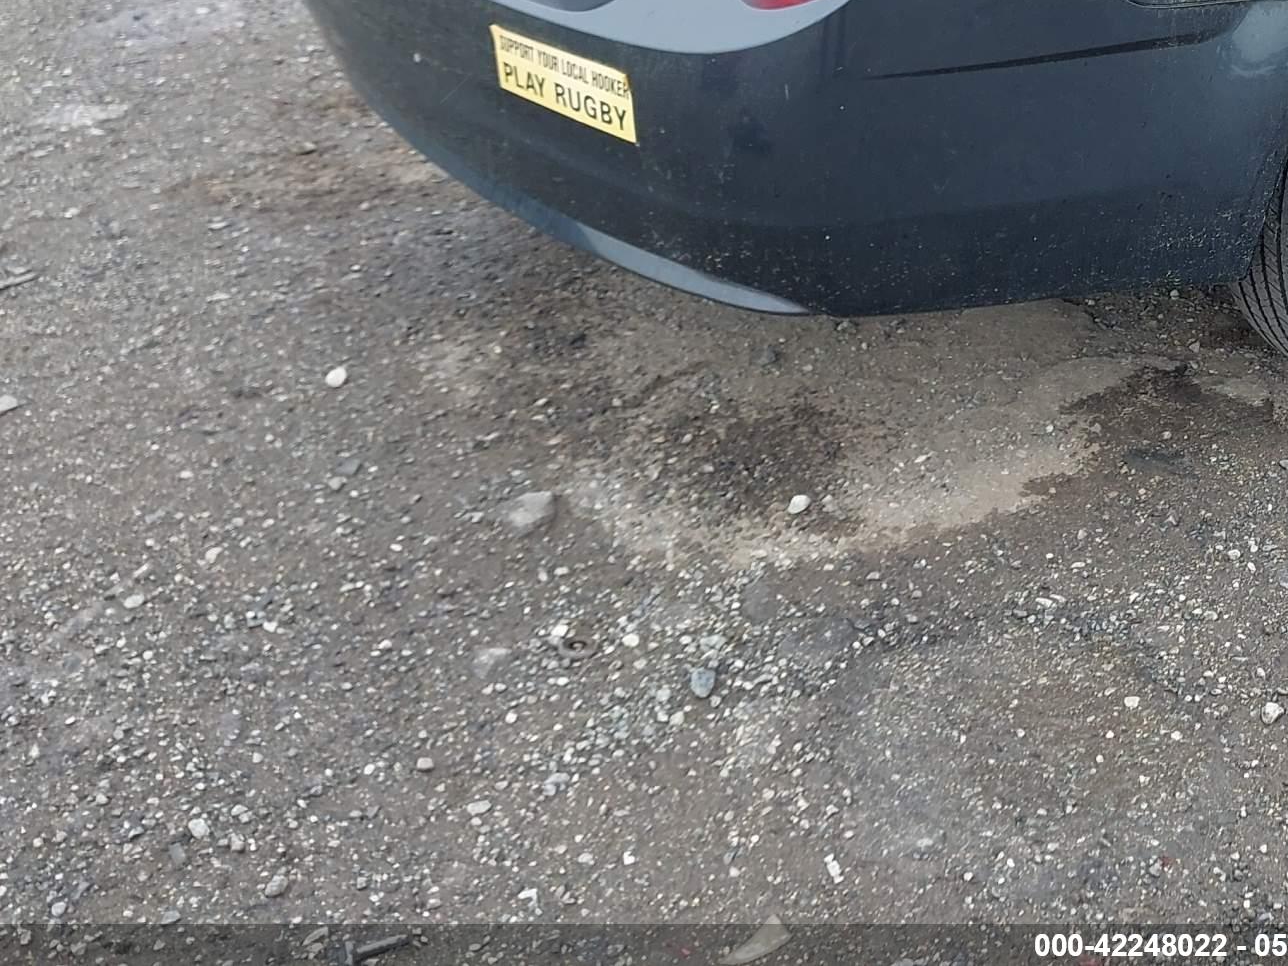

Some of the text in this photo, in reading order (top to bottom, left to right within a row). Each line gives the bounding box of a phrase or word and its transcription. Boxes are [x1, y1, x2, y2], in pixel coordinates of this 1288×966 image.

[500, 36, 630, 99] SUPPORT YOUR LOCAL HOOKER
[502, 62, 628, 131] PLAY RUGBY
